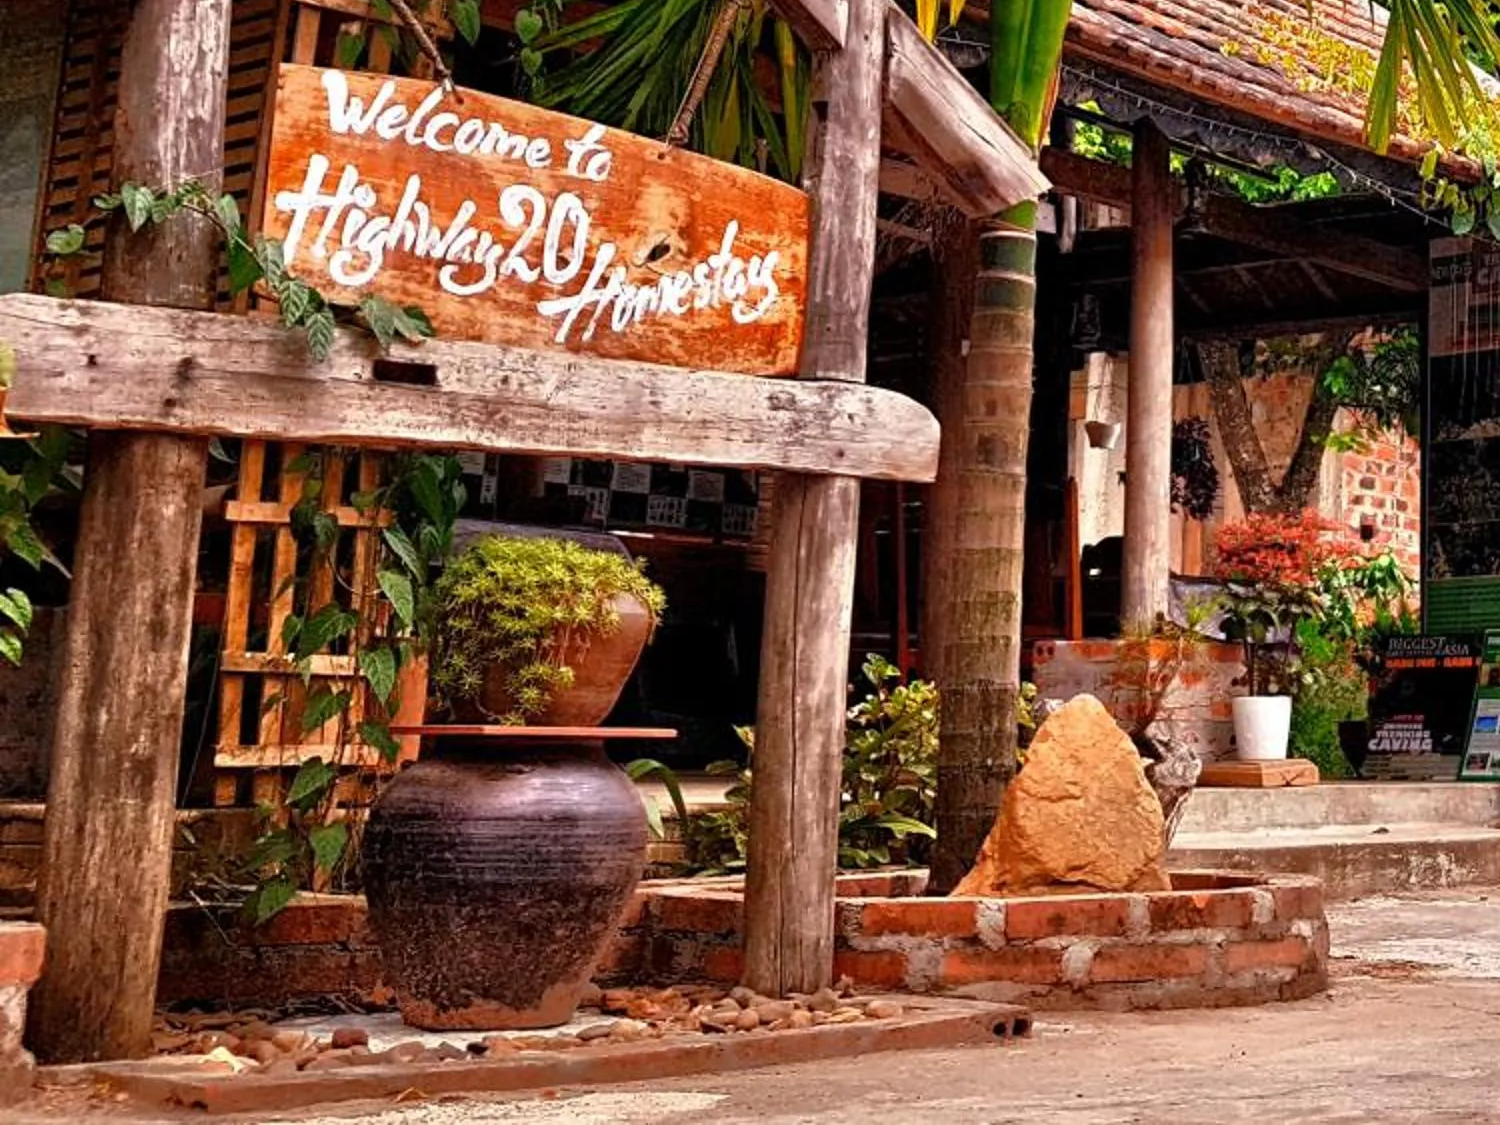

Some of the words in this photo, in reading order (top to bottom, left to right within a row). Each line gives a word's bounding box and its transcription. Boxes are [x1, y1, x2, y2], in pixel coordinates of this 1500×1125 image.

[321, 68, 552, 168] Welcome
[564, 121, 612, 181] to
[499, 185, 592, 284] 20
[538, 220, 779, 343] Homestay
[1367, 738, 1433, 753] CAVING
